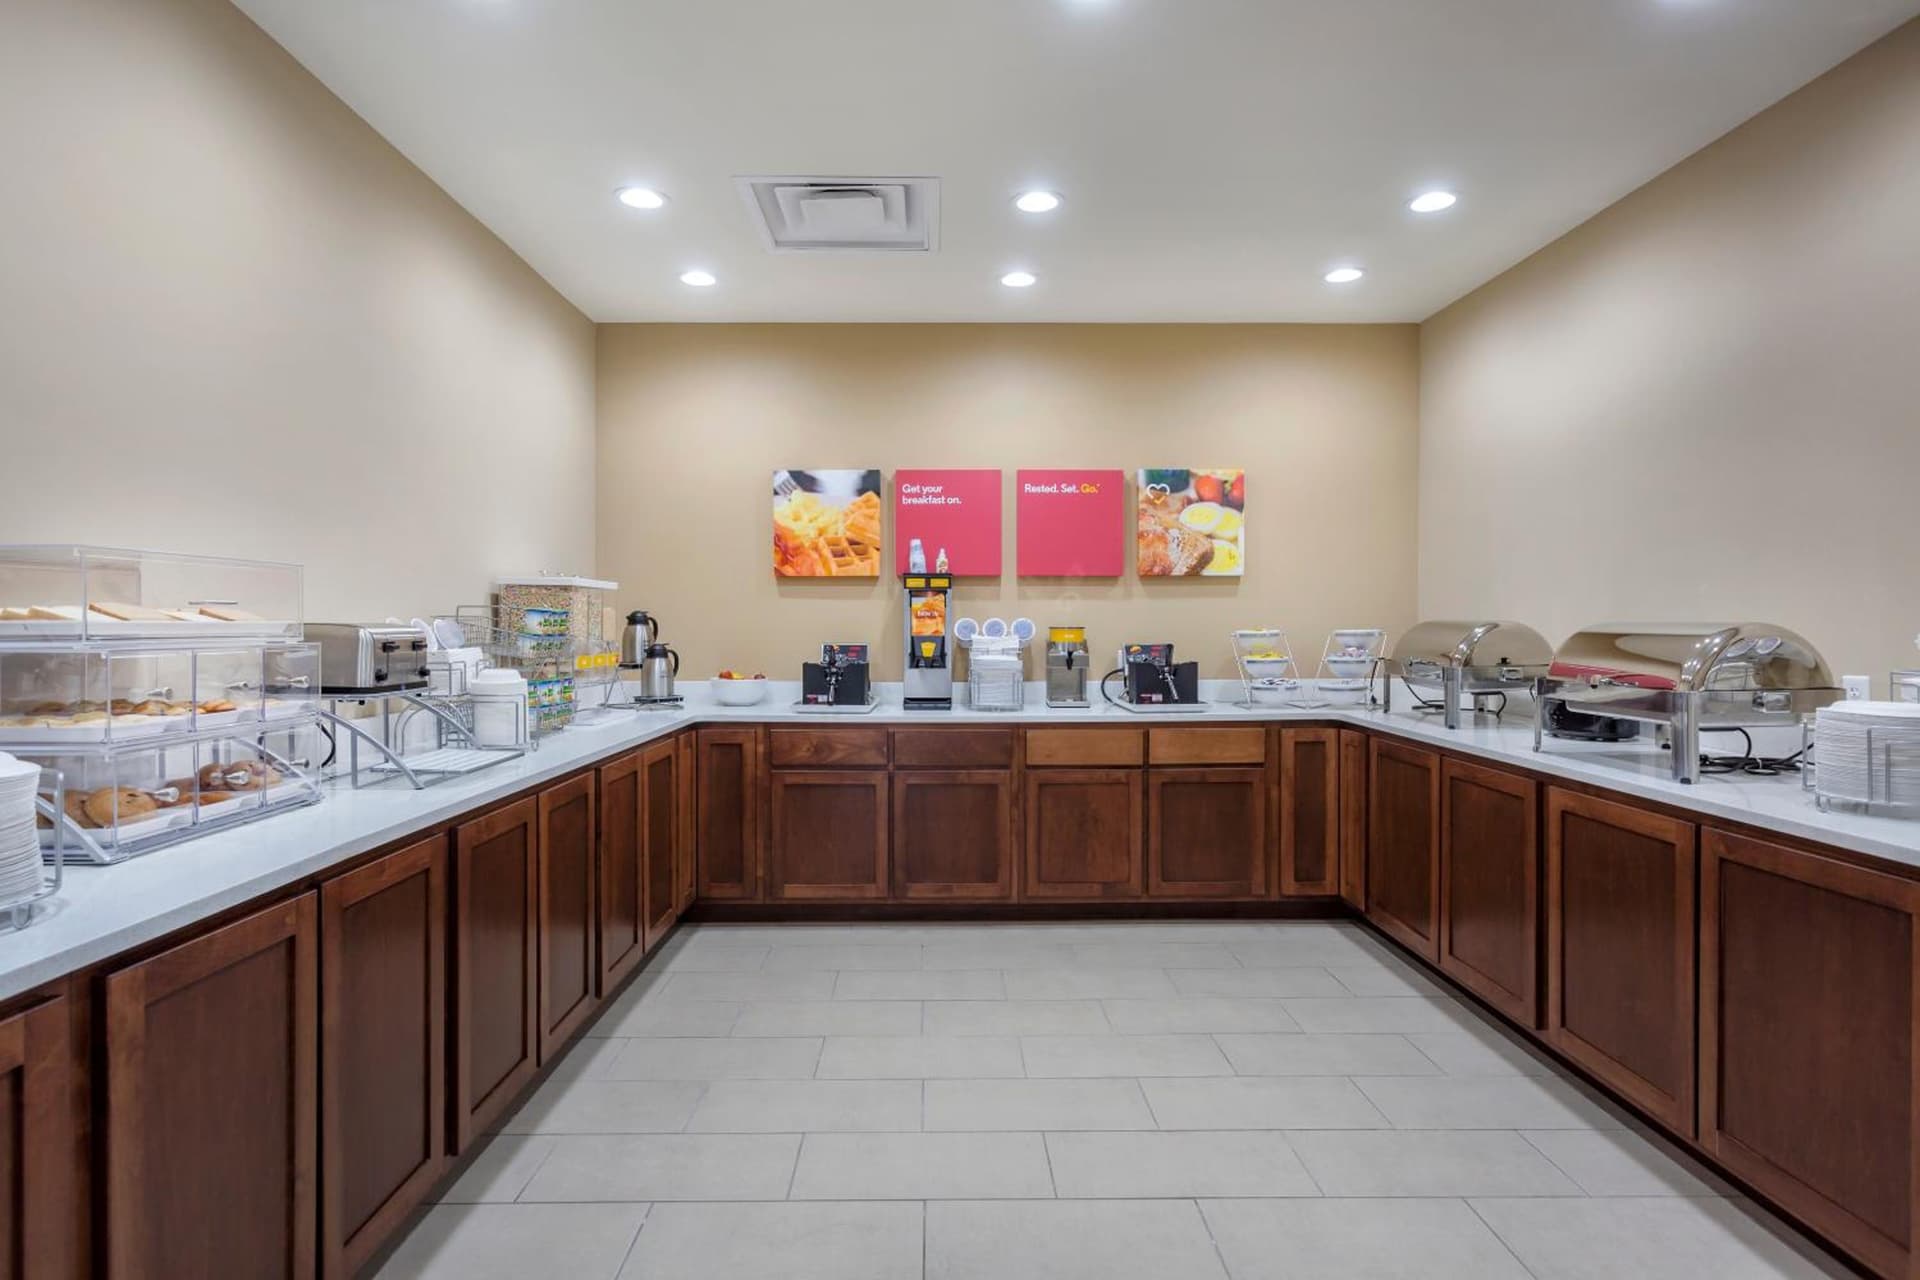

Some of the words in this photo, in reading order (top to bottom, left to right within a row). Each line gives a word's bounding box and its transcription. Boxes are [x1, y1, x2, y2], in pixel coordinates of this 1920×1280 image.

[902, 483, 920, 493] Get
[921, 486, 943, 495] your
[1024, 483, 1059, 493] Rested.
[1060, 483, 1079, 493] Set.
[902, 495, 945, 505] breakfast
[946, 497, 962, 505] on.
